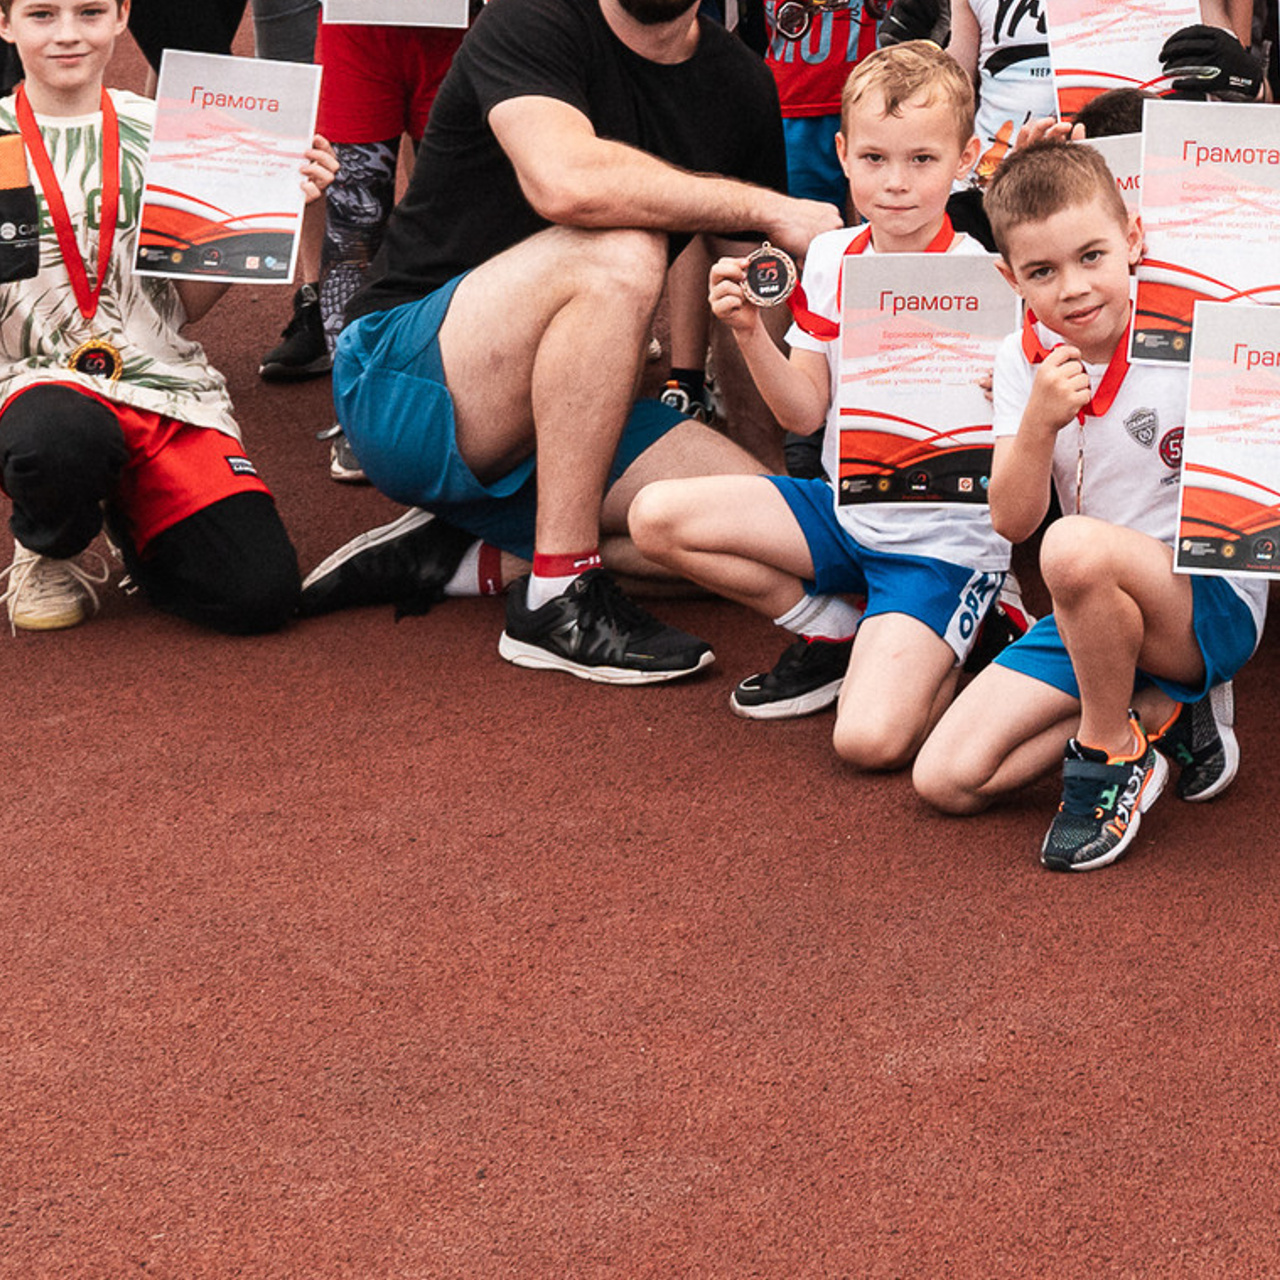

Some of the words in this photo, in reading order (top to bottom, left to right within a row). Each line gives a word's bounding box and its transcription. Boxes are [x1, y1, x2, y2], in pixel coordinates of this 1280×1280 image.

[191, 86, 279, 112] Грамота
[1183, 140, 1280, 167] Грамота
[879, 291, 979, 316] Грамота
